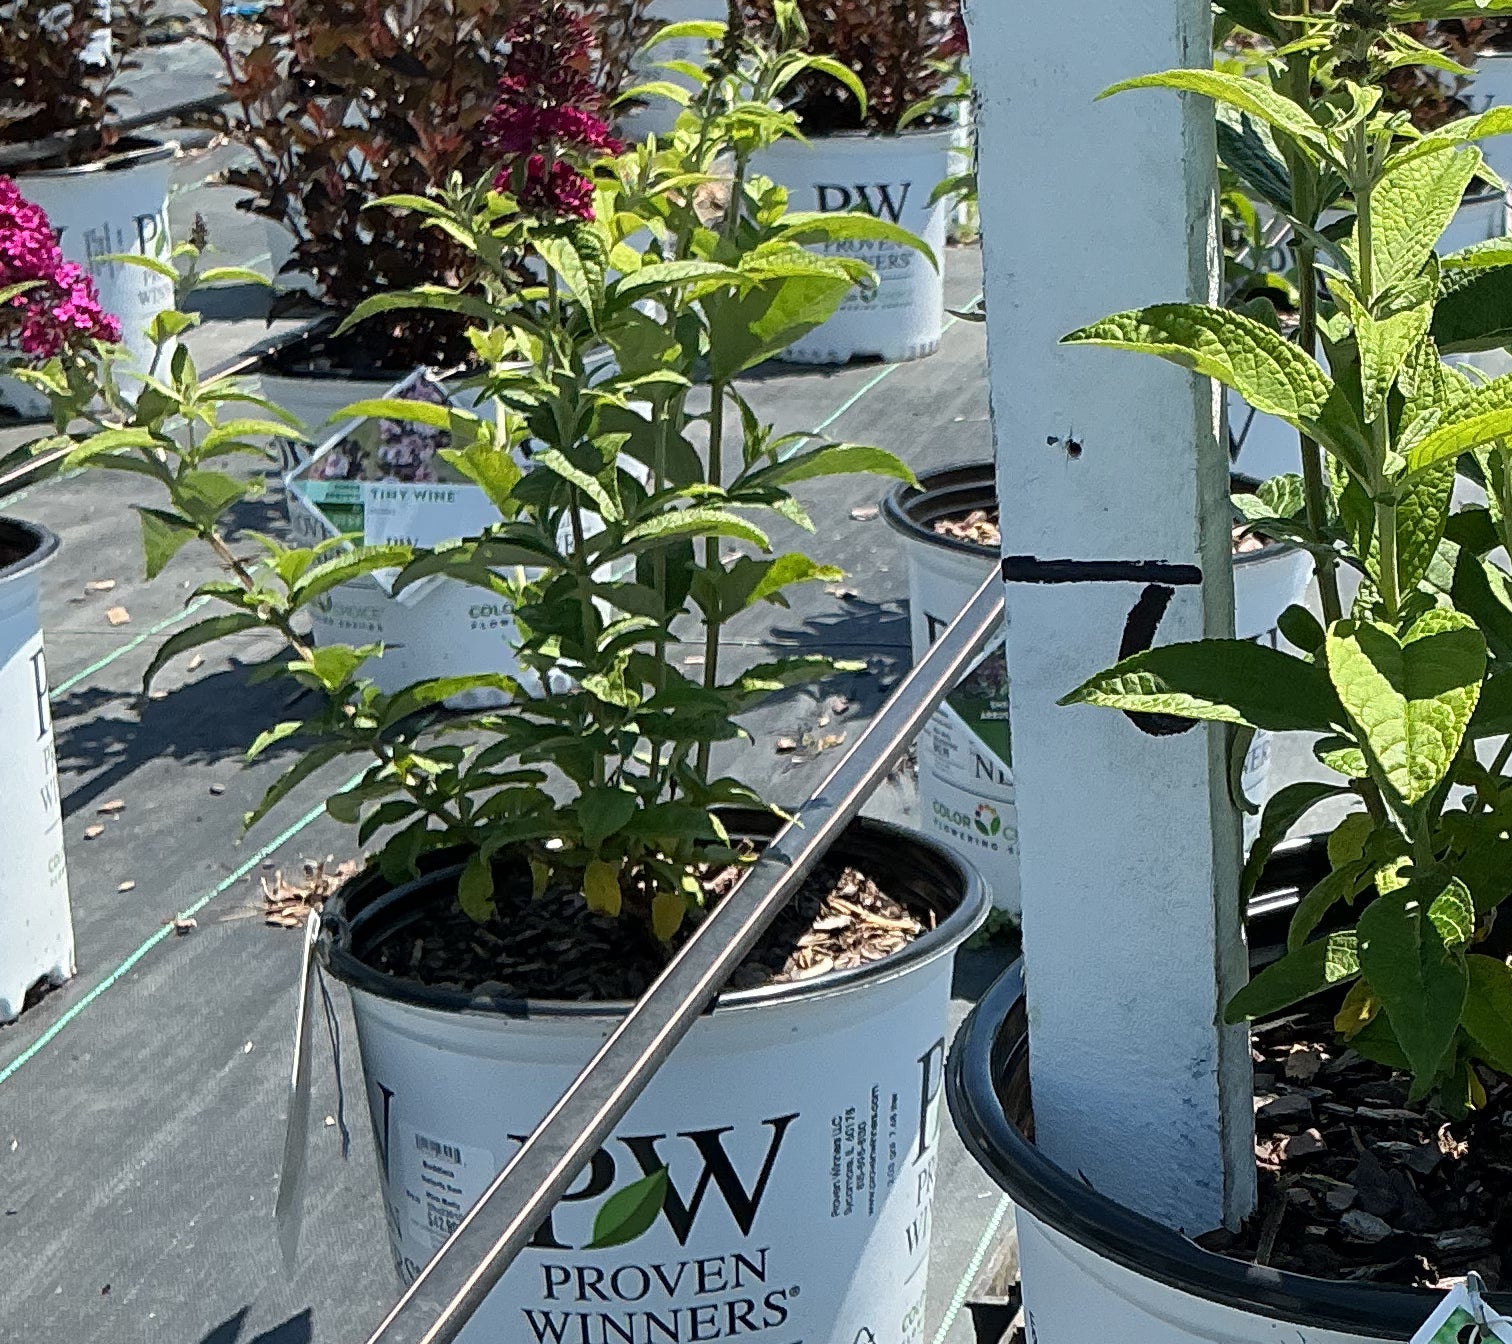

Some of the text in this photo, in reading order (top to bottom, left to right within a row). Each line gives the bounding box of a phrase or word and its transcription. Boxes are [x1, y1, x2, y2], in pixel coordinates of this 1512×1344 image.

[370, 488, 405, 502] TINY
[413, 489, 456, 505] WINE
[469, 602, 515, 619] COLO
[932, 798, 972, 829] COLOR
[506, 1111, 801, 1250] PW
[541, 1247, 770, 1303] PROVEN
